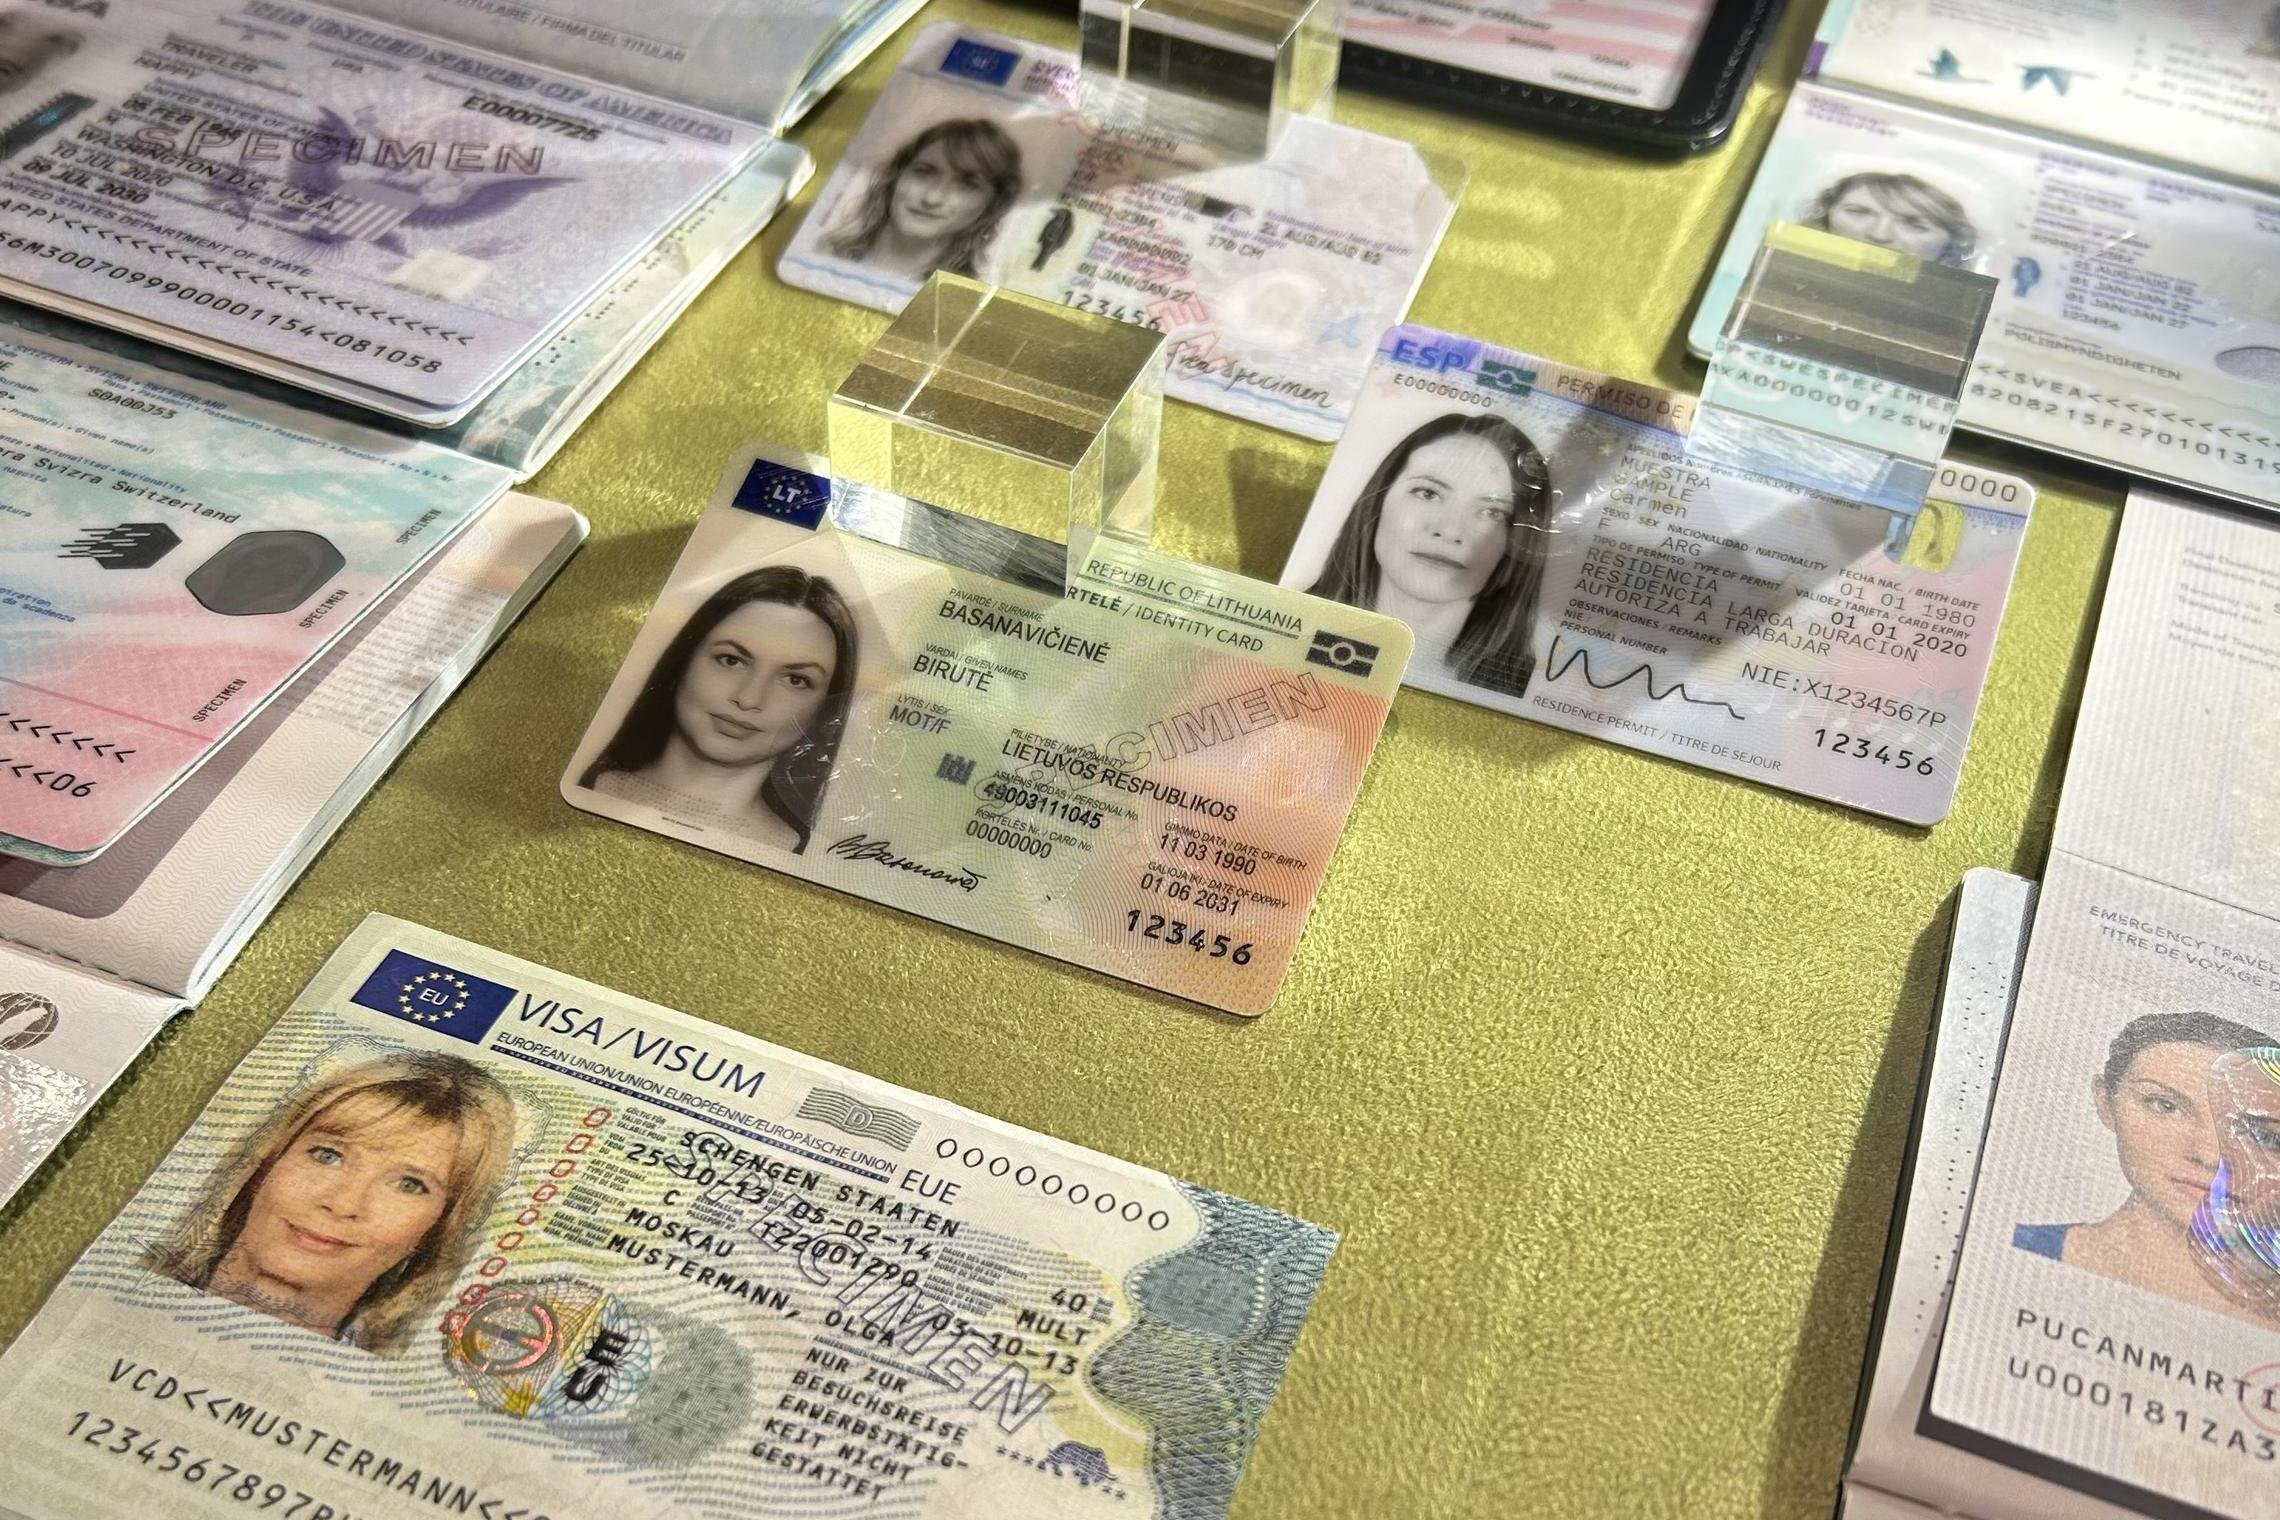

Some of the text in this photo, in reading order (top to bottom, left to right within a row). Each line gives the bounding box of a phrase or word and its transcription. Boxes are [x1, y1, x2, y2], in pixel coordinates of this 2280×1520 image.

[541, 16, 686, 64] FIRMA DEL TITULAR
[461, 94, 601, 143] E00007725
[78, 149, 116, 174] JUL
[134, 125, 545, 176] SPECIMEN
[53, 195, 314, 277] STATES DEPARTMENT OF STATE
[1393, 338, 1469, 372] ESP
[1556, 374, 1684, 420] PERMISO DE
[34, 456, 242, 524] Svizra Switzerland
[771, 484, 803, 504] LT
[1614, 472, 1695, 503] SAMPLE
[1620, 455, 1711, 490] MUESTRA
[1609, 487, 1688, 519] Carmen
[395, 507, 443, 546] SPECIMEN
[1660, 536, 1702, 557] ARG
[1667, 523, 1749, 552] NACIONALIDAD
[1755, 547, 1829, 573] NATIONALITY
[1586, 547, 1719, 593] RESIDENCIA
[1636, 546, 1781, 592] PERMISO TYPE PERMIT
[1838, 568, 1981, 612] FECHA BIRTH DATE
[298, 588, 350, 630] SPECIMEN
[997, 600, 1046, 623] SURNAME
[1086, 559, 1303, 634] REPUBLIC OF LITHUANIA
[1574, 578, 1831, 657] AUTORIZA A TRABAJAR
[1580, 562, 1918, 663] RESIDENCIA LARGA DURACION
[1794, 587, 1972, 641] VALIDEZ TARJETA CARD EXPIRY
[1839, 583, 1976, 629] 01 01 1980
[938, 599, 1111, 664] BASANAVIČIENĖ
[1135, 605, 1215, 638] IDENTITY
[1216, 628, 1264, 652] CARD
[1560, 620, 1669, 656] PERSONAL NUMBER
[1568, 598, 1723, 647] OBSERVACIONES REMARKS
[1830, 610, 1968, 658] 01 01 2020
[994, 663, 1029, 681] NAMES
[1741, 661, 1947, 729] NIE:X1234567P
[191, 678, 248, 724] SPECIMEN
[1531, 694, 1782, 772] RESIDENCE PERMIT TITRE DE SEJOUR
[1814, 728, 1935, 777] 123456
[1001, 738, 1239, 822] LIETUVOS RESPUBLIKOS
[1073, 793, 1124, 817] PERSONAL
[966, 819, 1054, 859] 00000000
[1048, 830, 1078, 848] CARD
[1159, 832, 1258, 876] 11 03 1990
[1201, 832, 1308, 872] DATA DATE OF BIRTH
[1140, 873, 1241, 916] 01 06 2031
[1207, 879, 1235, 896] DATE
[1235, 887, 1251, 900] OF
[1250, 891, 1290, 911] EXPIRY
[1127, 909, 1255, 966] 123456
[2088, 904, 2280, 975] EMERGENCY TRAVEL
[2100, 925, 2264, 987] TITRE DE VOYAGE
[417, 987, 451, 1008] EU
[496, 1030, 570, 1064] EUROPEAN
[569, 1052, 664, 1096] UNION/UNION
[850, 1146, 898, 1175] UNION
[843, 1103, 875, 1131] D
[663, 1188, 681, 1206] C
[679, 1130, 821, 1192] SCHENGEN
[835, 1186, 962, 1240] STAATEN
[899, 1168, 962, 1207] EUE
[624, 1206, 736, 1258] MOSKAU
[606, 1233, 897, 1348] MUSTERMANN, OLGA
[1051, 1287, 1088, 1313] 40
[1015, 1307, 1091, 1346] MULT
[805, 1348, 851, 1374] NUR
[862, 1367, 910, 1395] ZUR
[791, 1369, 970, 1444] BESUCHSREISE
[750, 1441, 888, 1501] GESTATTET
[763, 1416, 916, 1482] KEIT NICHT
